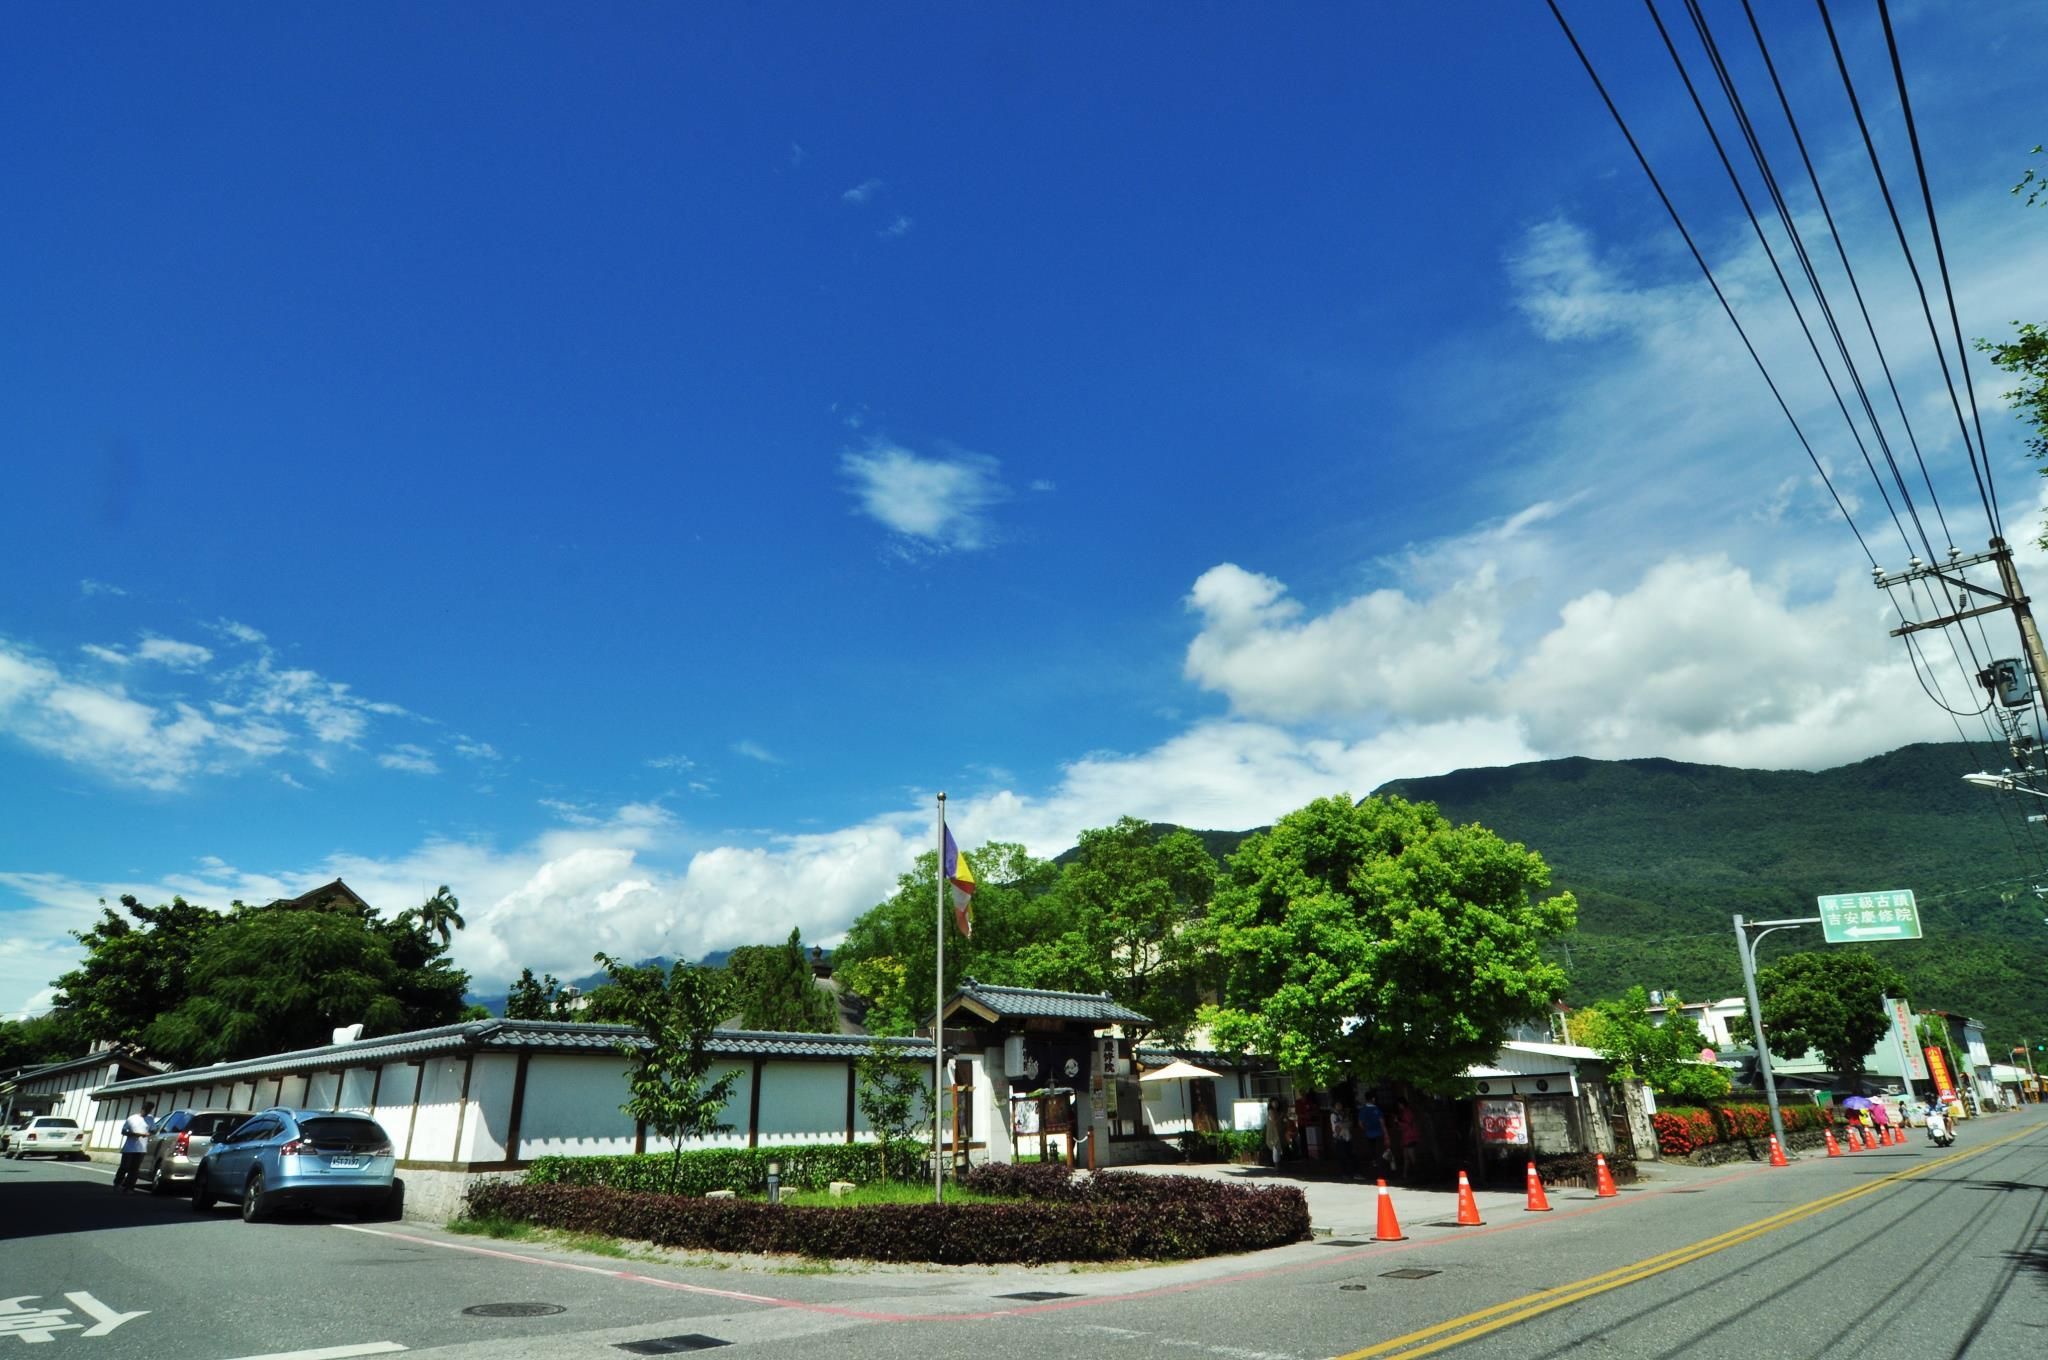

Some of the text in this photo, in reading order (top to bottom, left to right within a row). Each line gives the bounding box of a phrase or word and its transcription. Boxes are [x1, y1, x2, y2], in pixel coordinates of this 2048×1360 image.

[1827, 907, 1913, 926] 吉安慶修院
